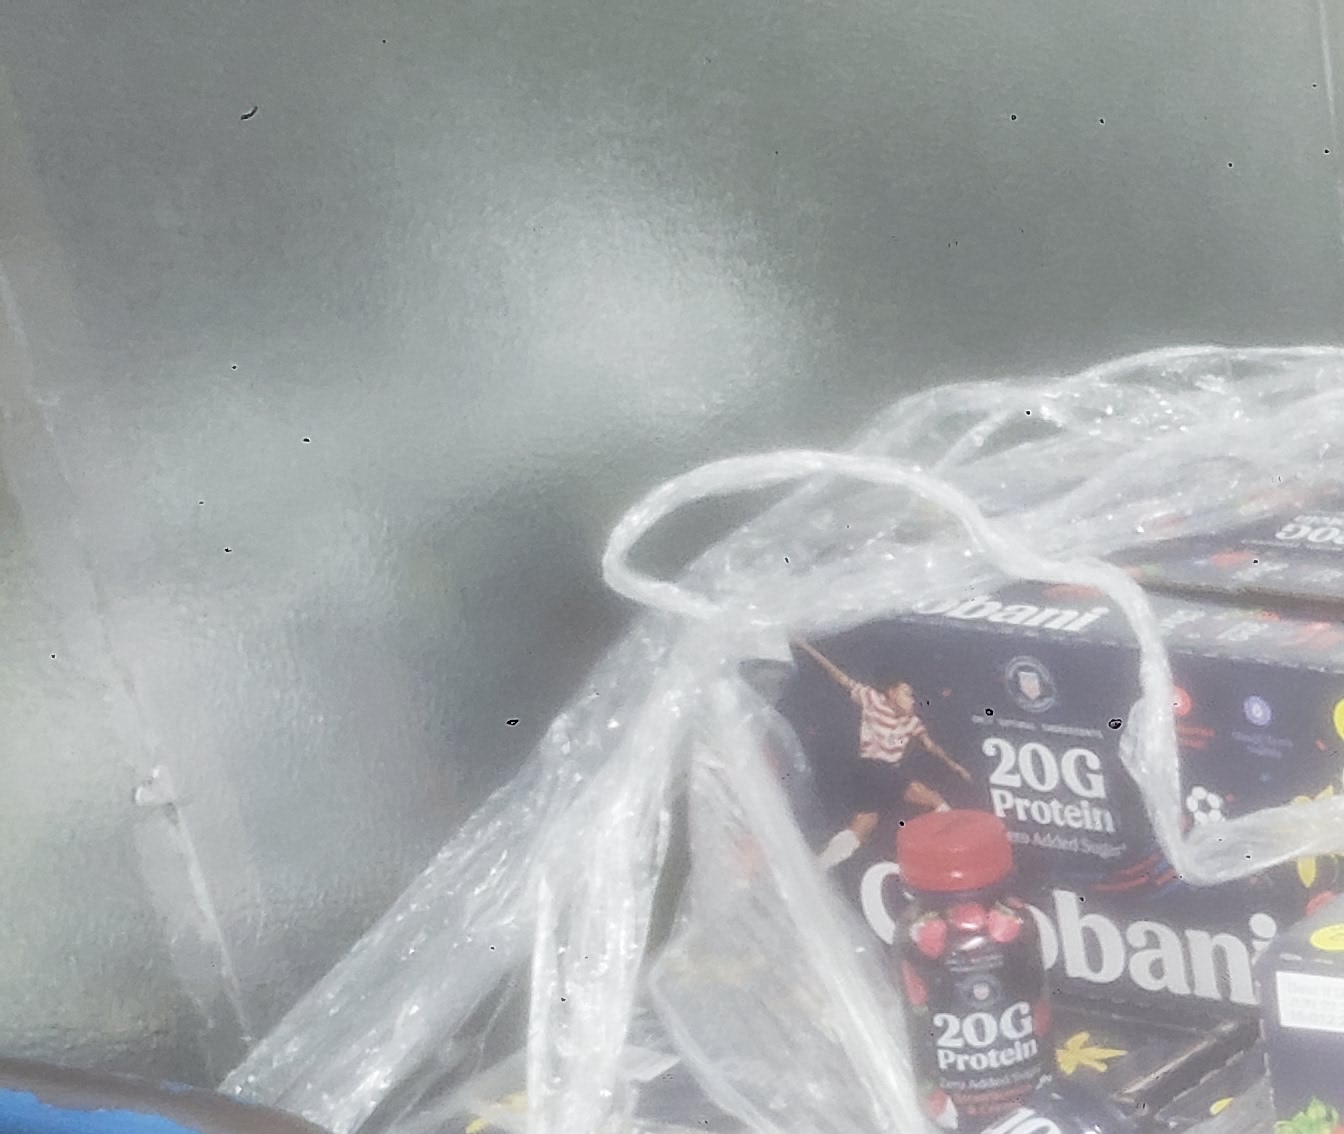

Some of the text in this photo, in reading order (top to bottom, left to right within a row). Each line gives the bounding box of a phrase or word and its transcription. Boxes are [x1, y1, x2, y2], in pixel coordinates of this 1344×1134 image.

[981, 736, 1107, 798] 20G
[989, 787, 1117, 834] Protein
[933, 1001, 1035, 1049] 20G
[936, 1037, 1039, 1075] Protein
